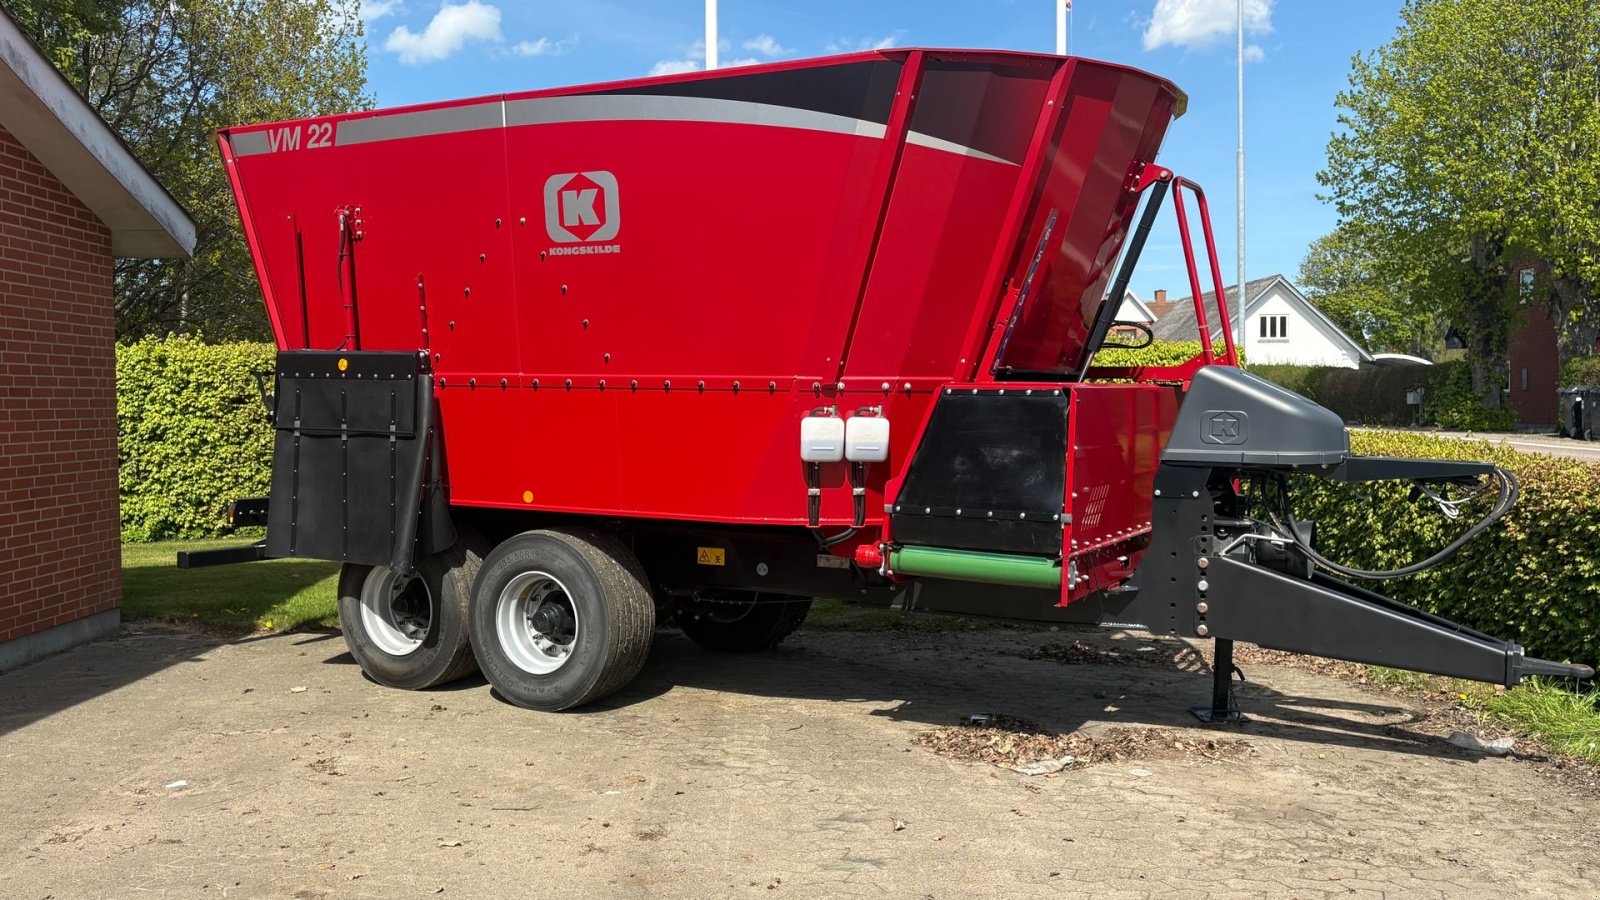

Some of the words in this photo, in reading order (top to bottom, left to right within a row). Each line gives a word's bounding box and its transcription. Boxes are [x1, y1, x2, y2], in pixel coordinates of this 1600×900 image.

[268, 126, 302, 153] VM
[306, 122, 333, 149] 22
[562, 188, 601, 227] K
[549, 244, 621, 256] KONGSKILDE
